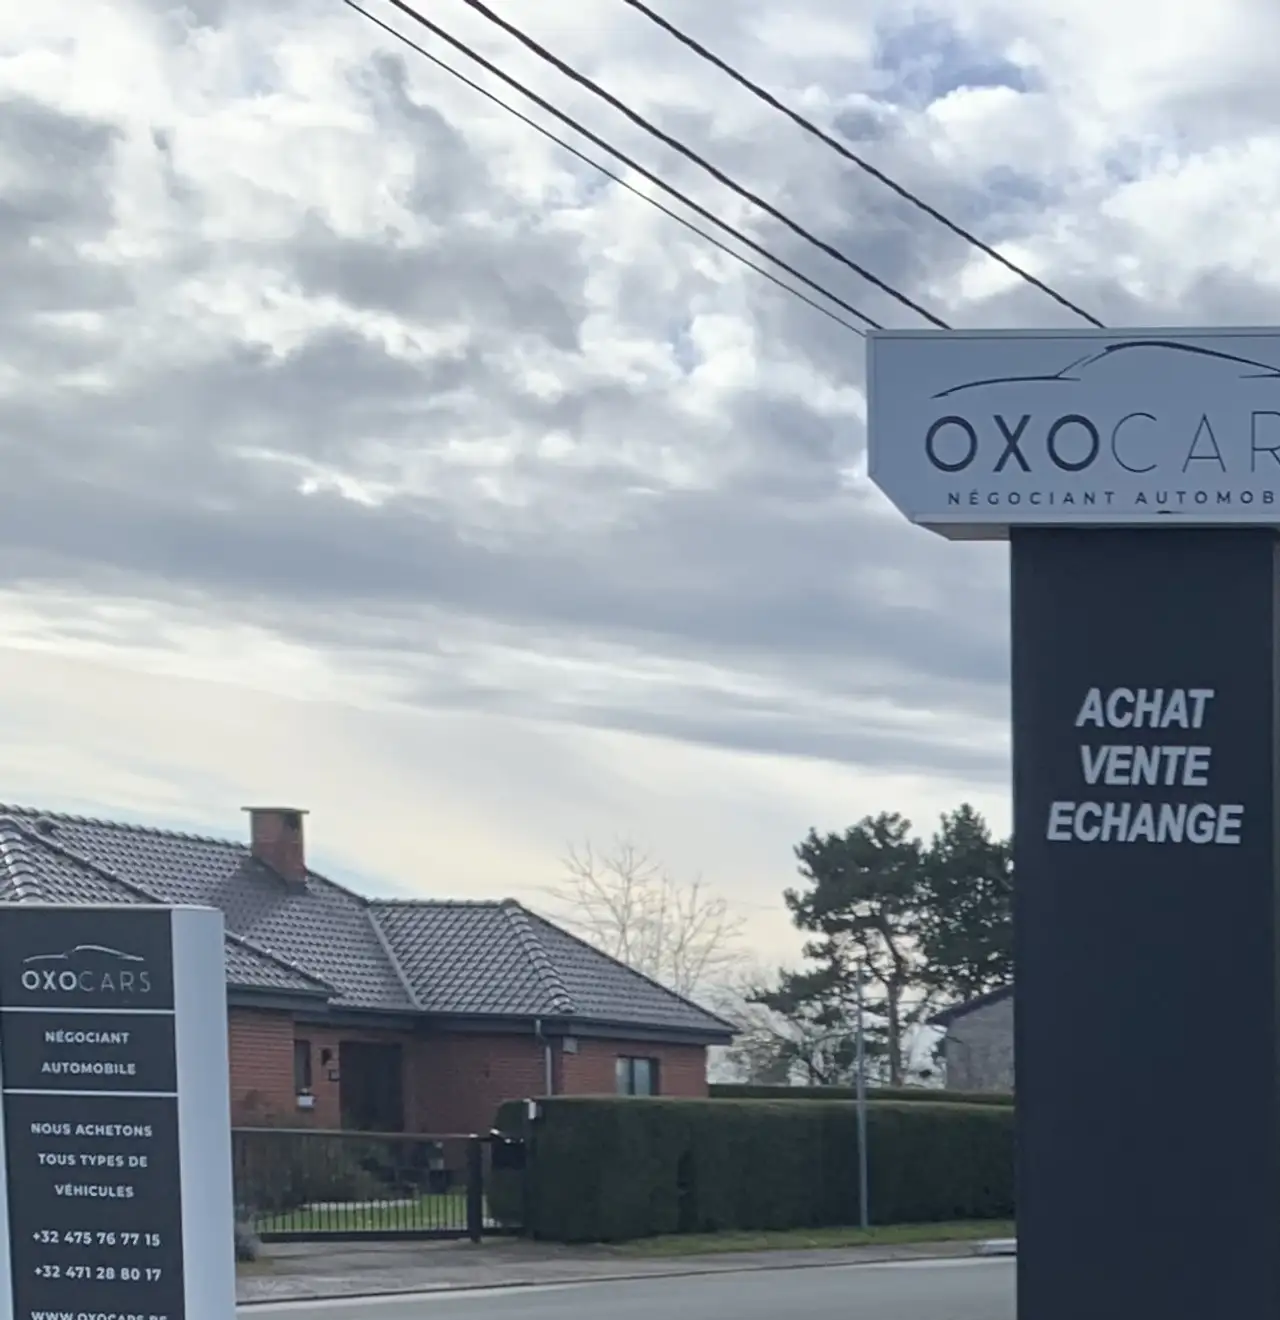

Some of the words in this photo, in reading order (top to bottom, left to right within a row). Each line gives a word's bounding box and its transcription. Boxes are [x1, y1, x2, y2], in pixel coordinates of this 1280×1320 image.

[948, 488, 1115, 505] NÉGOCIANT
[1075, 686, 1215, 729] ACHAT
[1080, 744, 1212, 786] VENTE
[1047, 801, 1244, 844] ECHANGE
[21, 970, 151, 993] OXOCARS
[45, 1028, 130, 1044] NÉGOCIANT
[41, 1061, 137, 1076] AUTOMOBILE
[31, 1122, 71, 1135] NOUS
[75, 1123, 153, 1137] ACHETONS
[38, 1153, 76, 1166] TOUS
[80, 1154, 124, 1168] TYPES
[128, 1155, 148, 1168] DE
[54, 1182, 135, 1198] VÉHICULES
[32, 1229, 60, 1244] +32
[64, 1231, 92, 1244] 475
[97, 1232, 116, 1245] 76
[121, 1233, 140, 1246] 77
[144, 1233, 161, 1246] 15
[34, 1264, 60, 1278] +32
[65, 1265, 91, 1278] 471
[96, 1266, 115, 1279] 28
[120, 1267, 140, 1280] 80
[145, 1268, 162, 1281] 17
